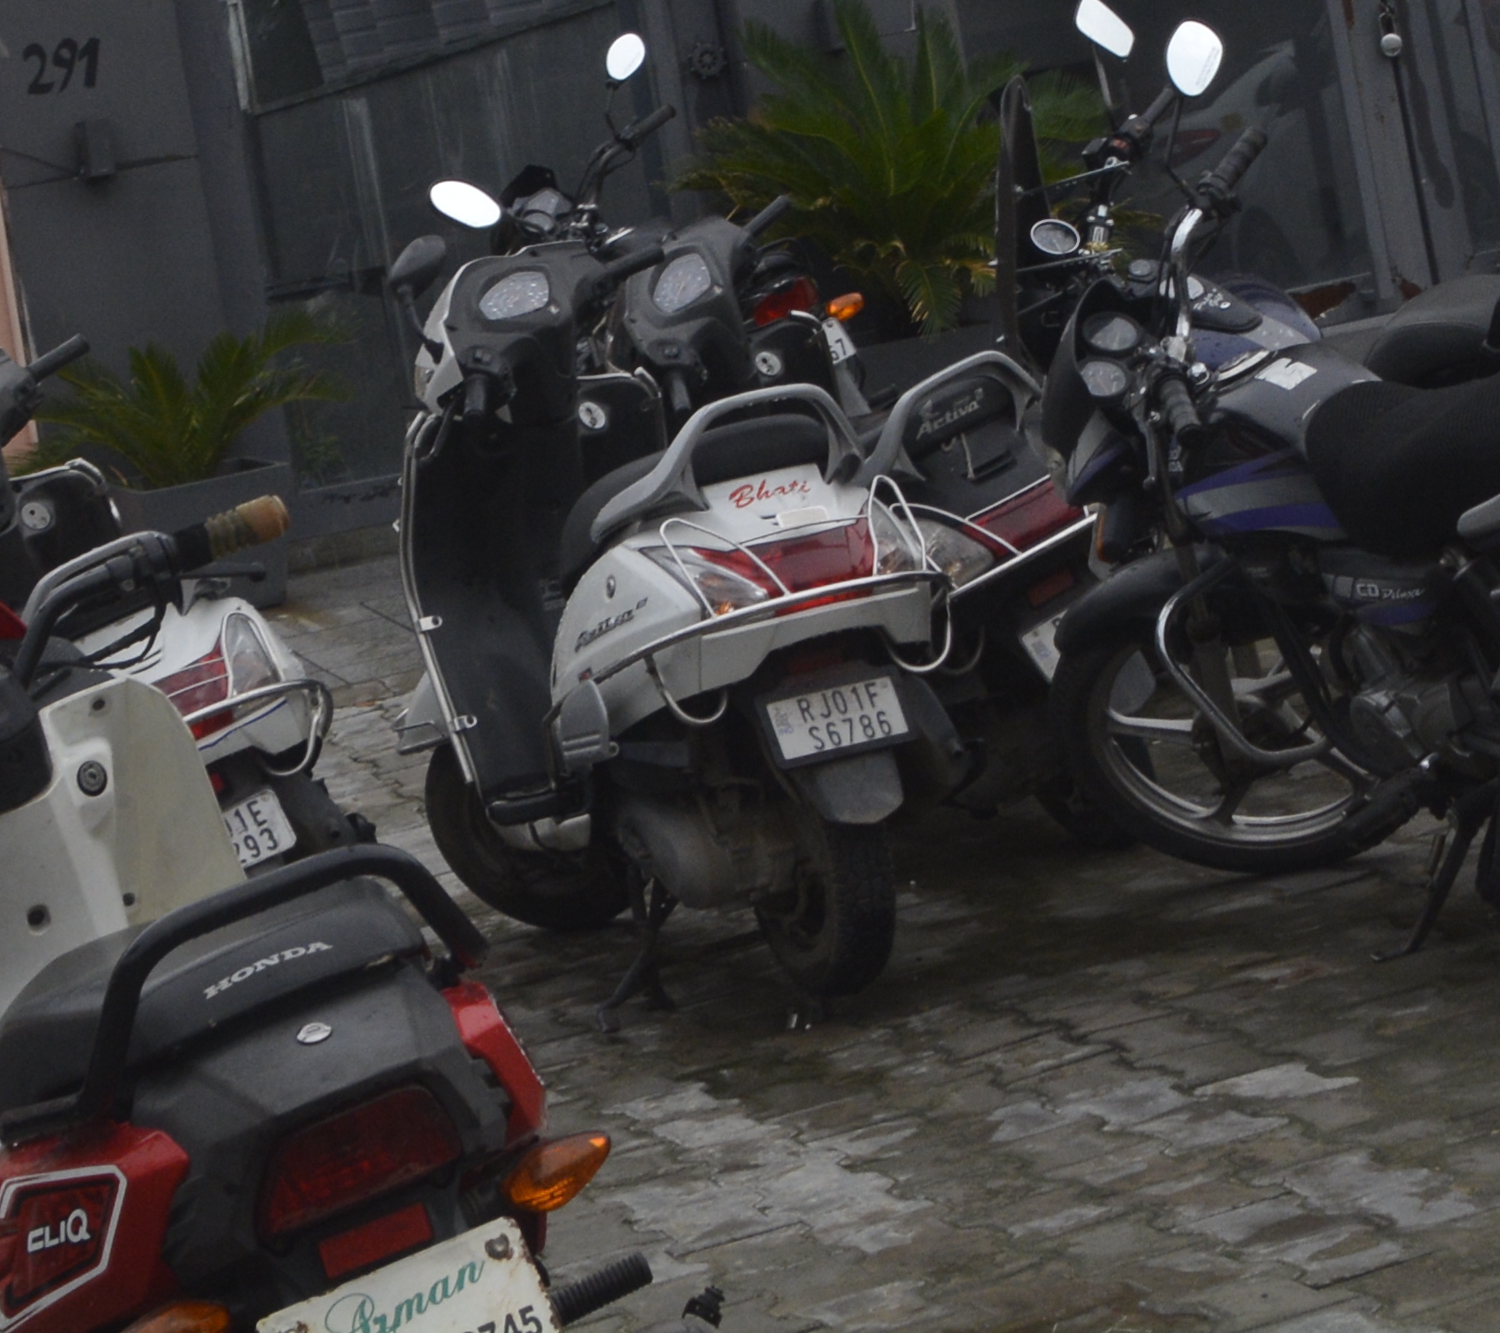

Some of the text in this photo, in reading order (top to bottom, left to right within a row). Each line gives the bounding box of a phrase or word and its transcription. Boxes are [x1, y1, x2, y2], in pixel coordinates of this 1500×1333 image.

[22, 37, 100, 95] 291
[916, 399, 980, 440] Activa
[729, 479, 811, 509] Bhati
[797, 682, 879, 723] RJ01F
[809, 711, 892, 751] S6786
[203, 941, 333, 999] HONDA
[27, 1208, 91, 1253] CLIQ
